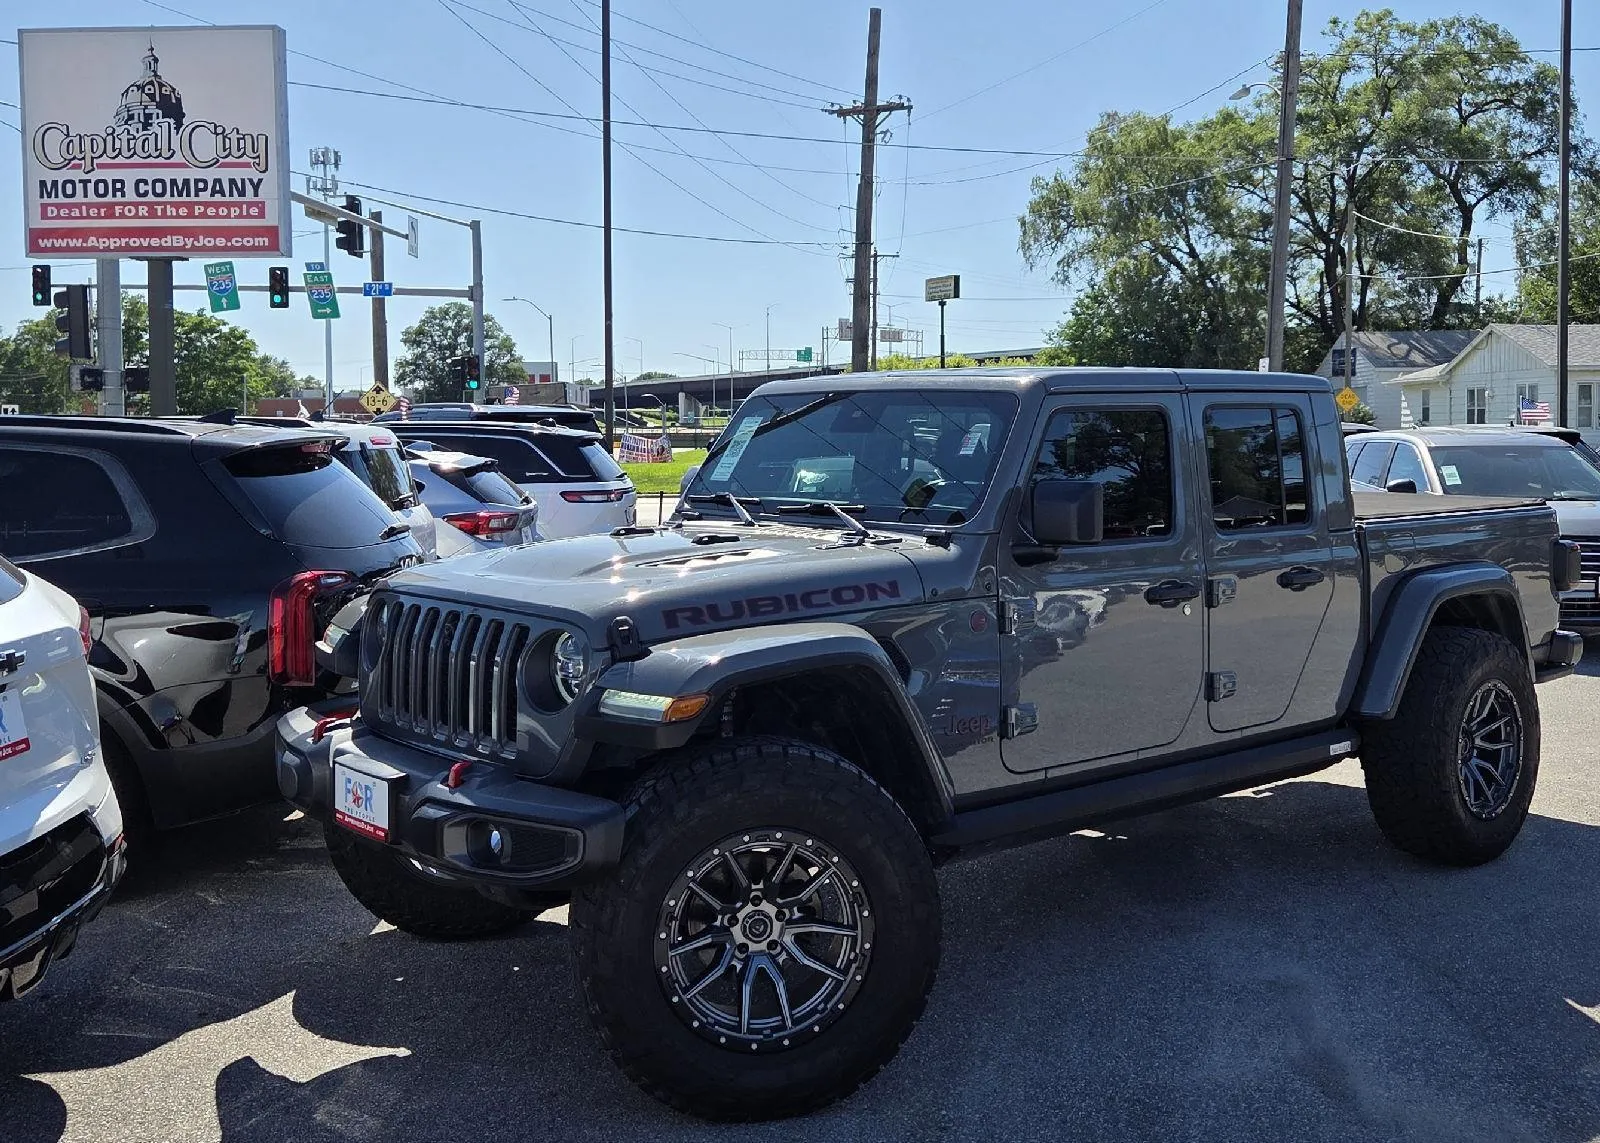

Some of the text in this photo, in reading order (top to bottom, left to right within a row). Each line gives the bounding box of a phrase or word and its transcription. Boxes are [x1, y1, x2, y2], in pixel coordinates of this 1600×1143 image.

[33, 119, 268, 174] Capital City
[39, 177, 264, 199] MOTOR COMPANY
[47, 204, 259, 219] Dealer FOR The People
[38, 235, 269, 249] www.ApprovedByJoe.com
[207, 264, 230, 274] WEST
[310, 263, 321, 271] TO
[212, 280, 232, 291] 235
[306, 274, 329, 283] EAST
[311, 288, 331, 299] 235
[661, 580, 901, 629] RUBICON
[944, 715, 989, 738] Jeep
